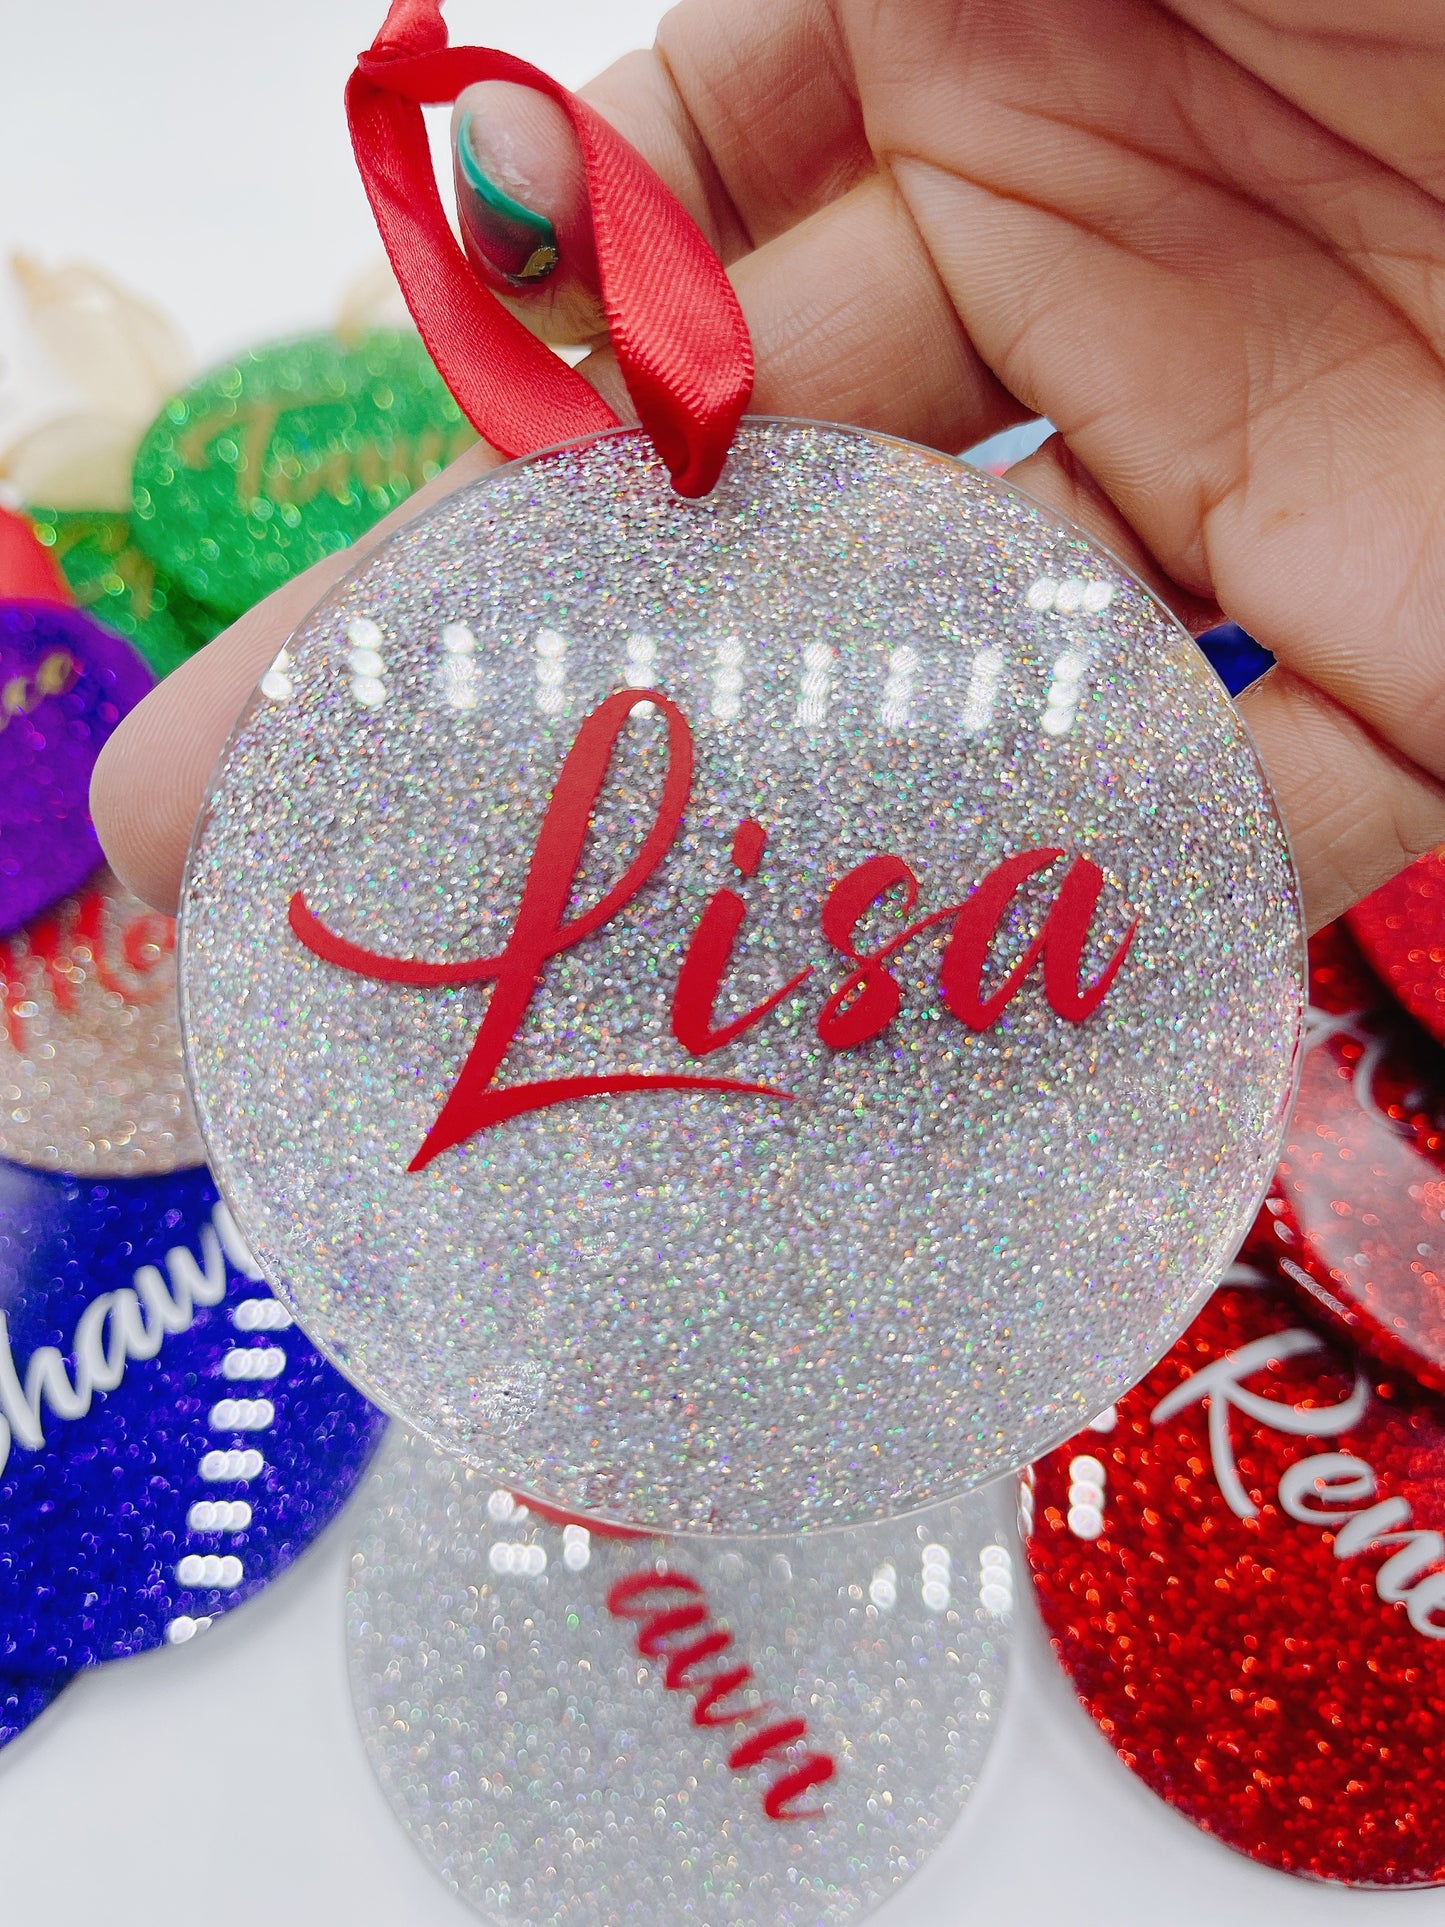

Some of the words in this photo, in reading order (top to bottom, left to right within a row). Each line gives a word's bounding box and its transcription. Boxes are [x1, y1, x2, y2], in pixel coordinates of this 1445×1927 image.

[288, 688, 1142, 1172] Lisa
[0, 1199, 265, 1475] haw
[512, 1492, 838, 1821] awn
